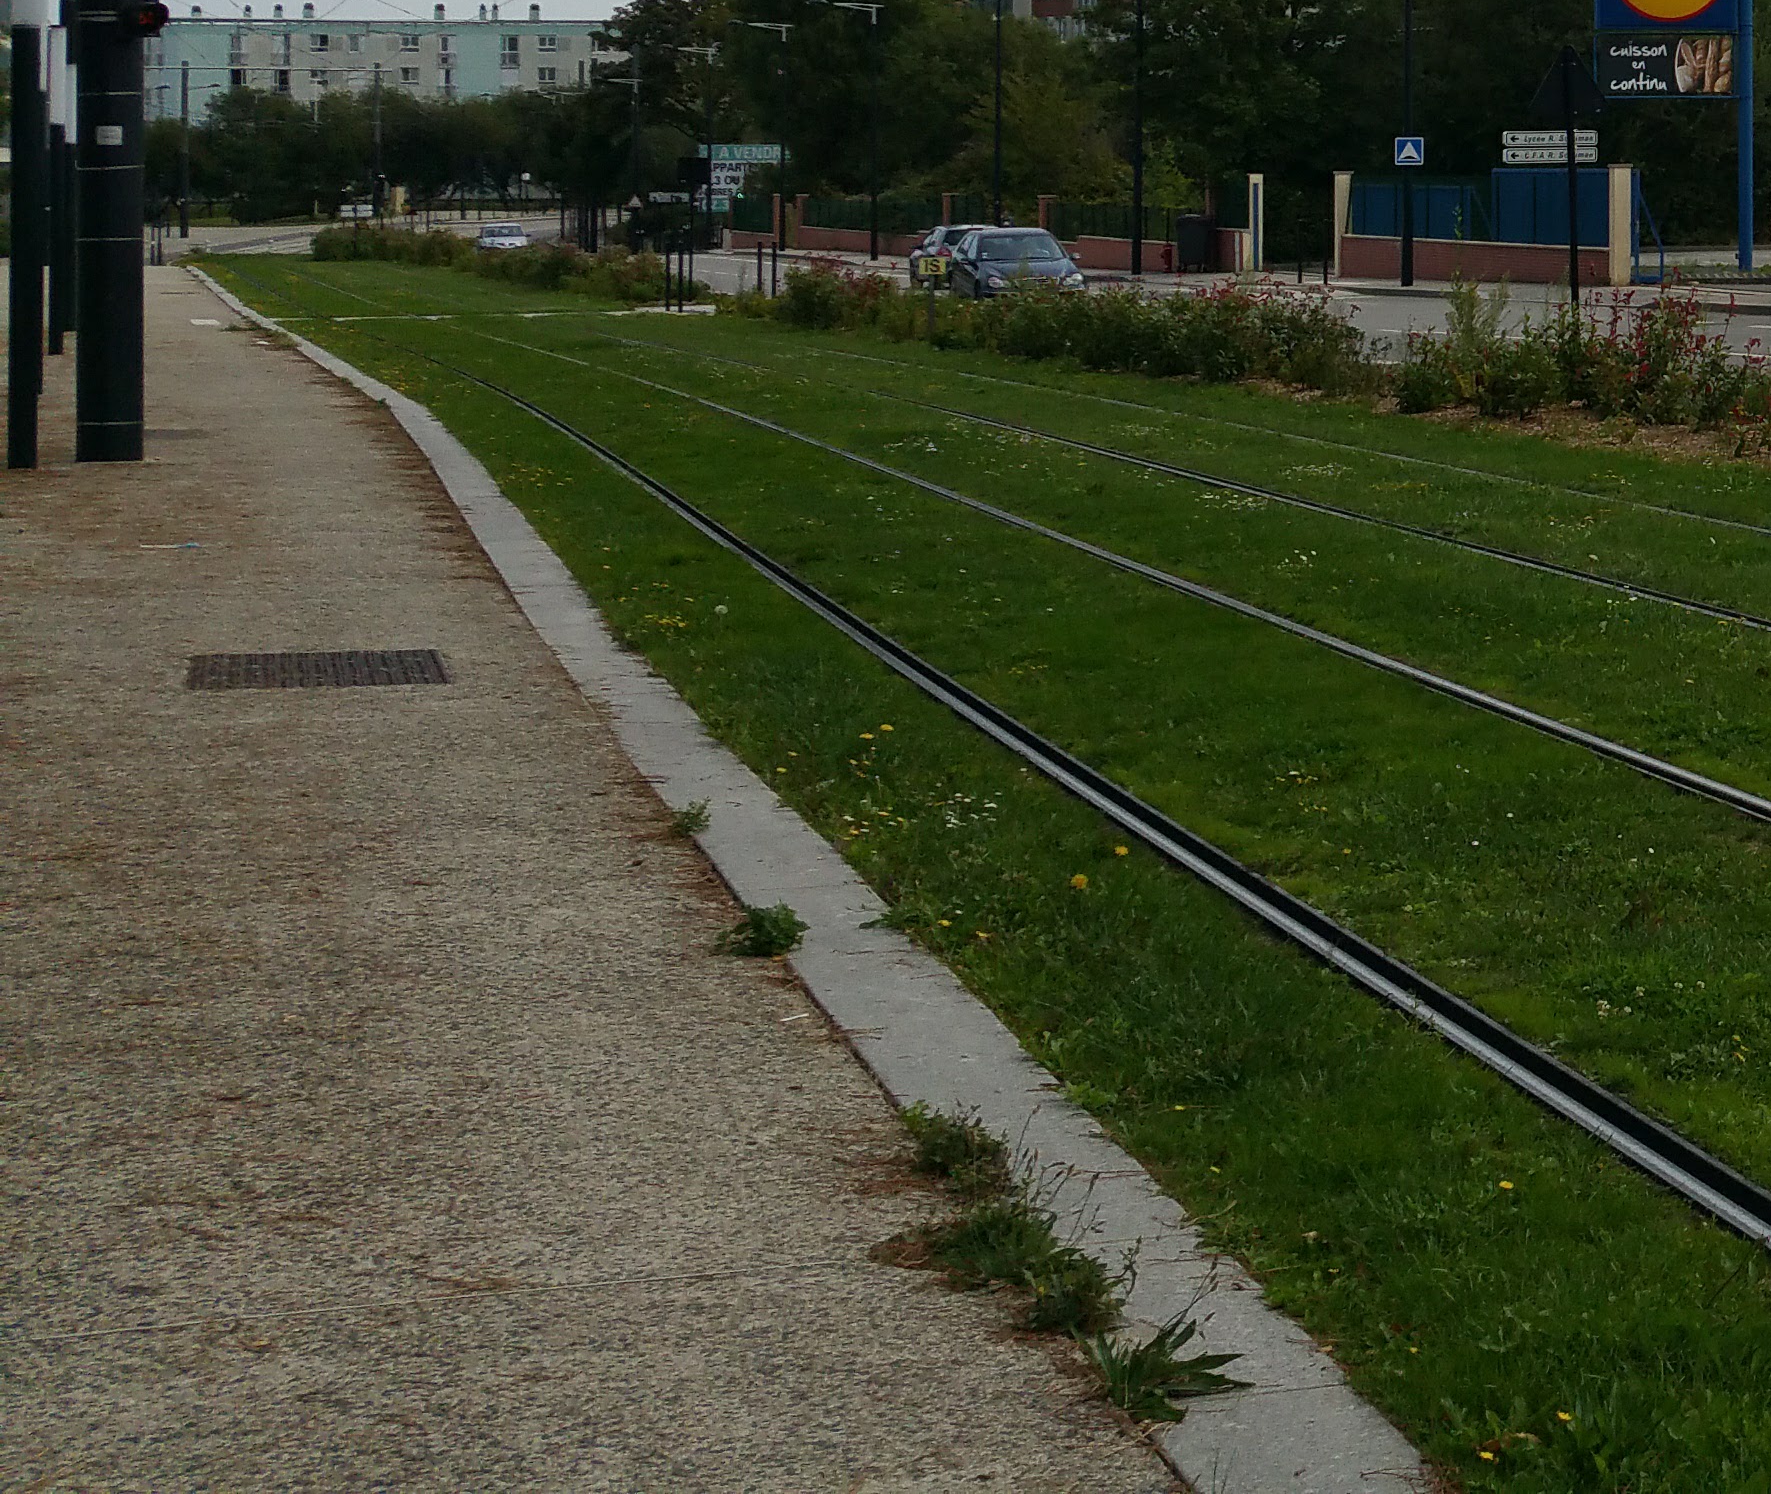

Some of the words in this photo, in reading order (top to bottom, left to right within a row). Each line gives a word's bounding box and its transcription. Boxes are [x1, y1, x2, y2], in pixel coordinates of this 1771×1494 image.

[1610, 41, 1668, 57] cuisson
[1631, 58, 1646, 69] en
[1610, 72, 1668, 91] continu
[925, 259, 942, 273] IS
